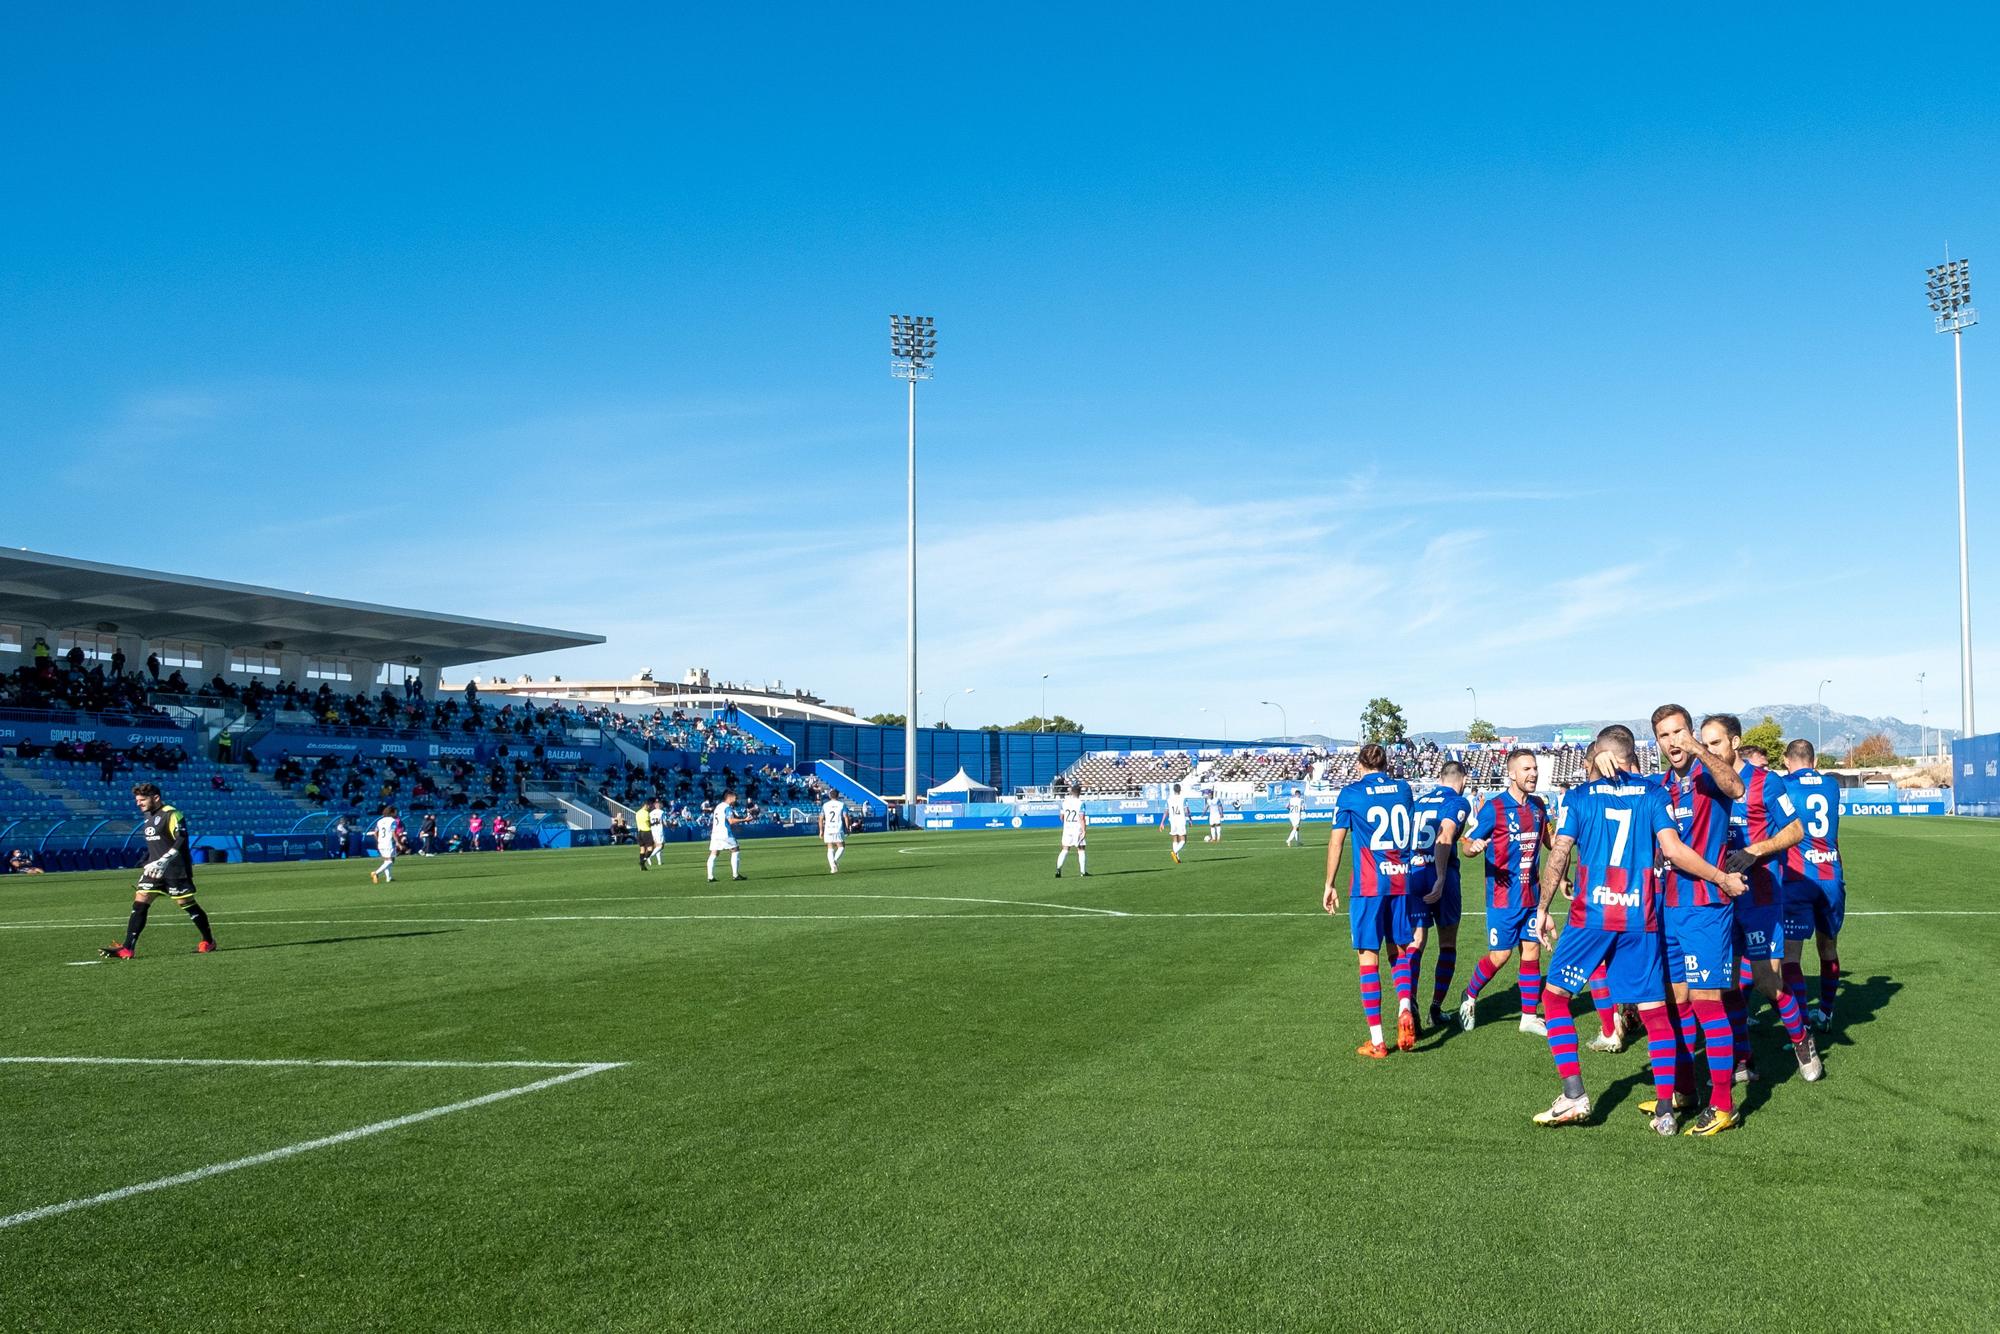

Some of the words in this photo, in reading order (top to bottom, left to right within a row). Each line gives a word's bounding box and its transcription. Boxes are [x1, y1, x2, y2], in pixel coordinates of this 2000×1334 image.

[144, 735, 184, 744] HYUNDAI
[829, 811, 836, 823] 2
[1065, 809, 1078, 823] 22
[1171, 806, 1181, 815] 14
[1806, 793, 1829, 838] 3
[1852, 804, 1893, 815] Bankia
[381, 827, 386, 838] 3
[1367, 803, 1410, 851] 20
[1411, 809, 1438, 851] 15
[1605, 807, 1633, 867] 7
[1592, 885, 1640, 907] fibwi
[1490, 927, 1499, 947] 6
